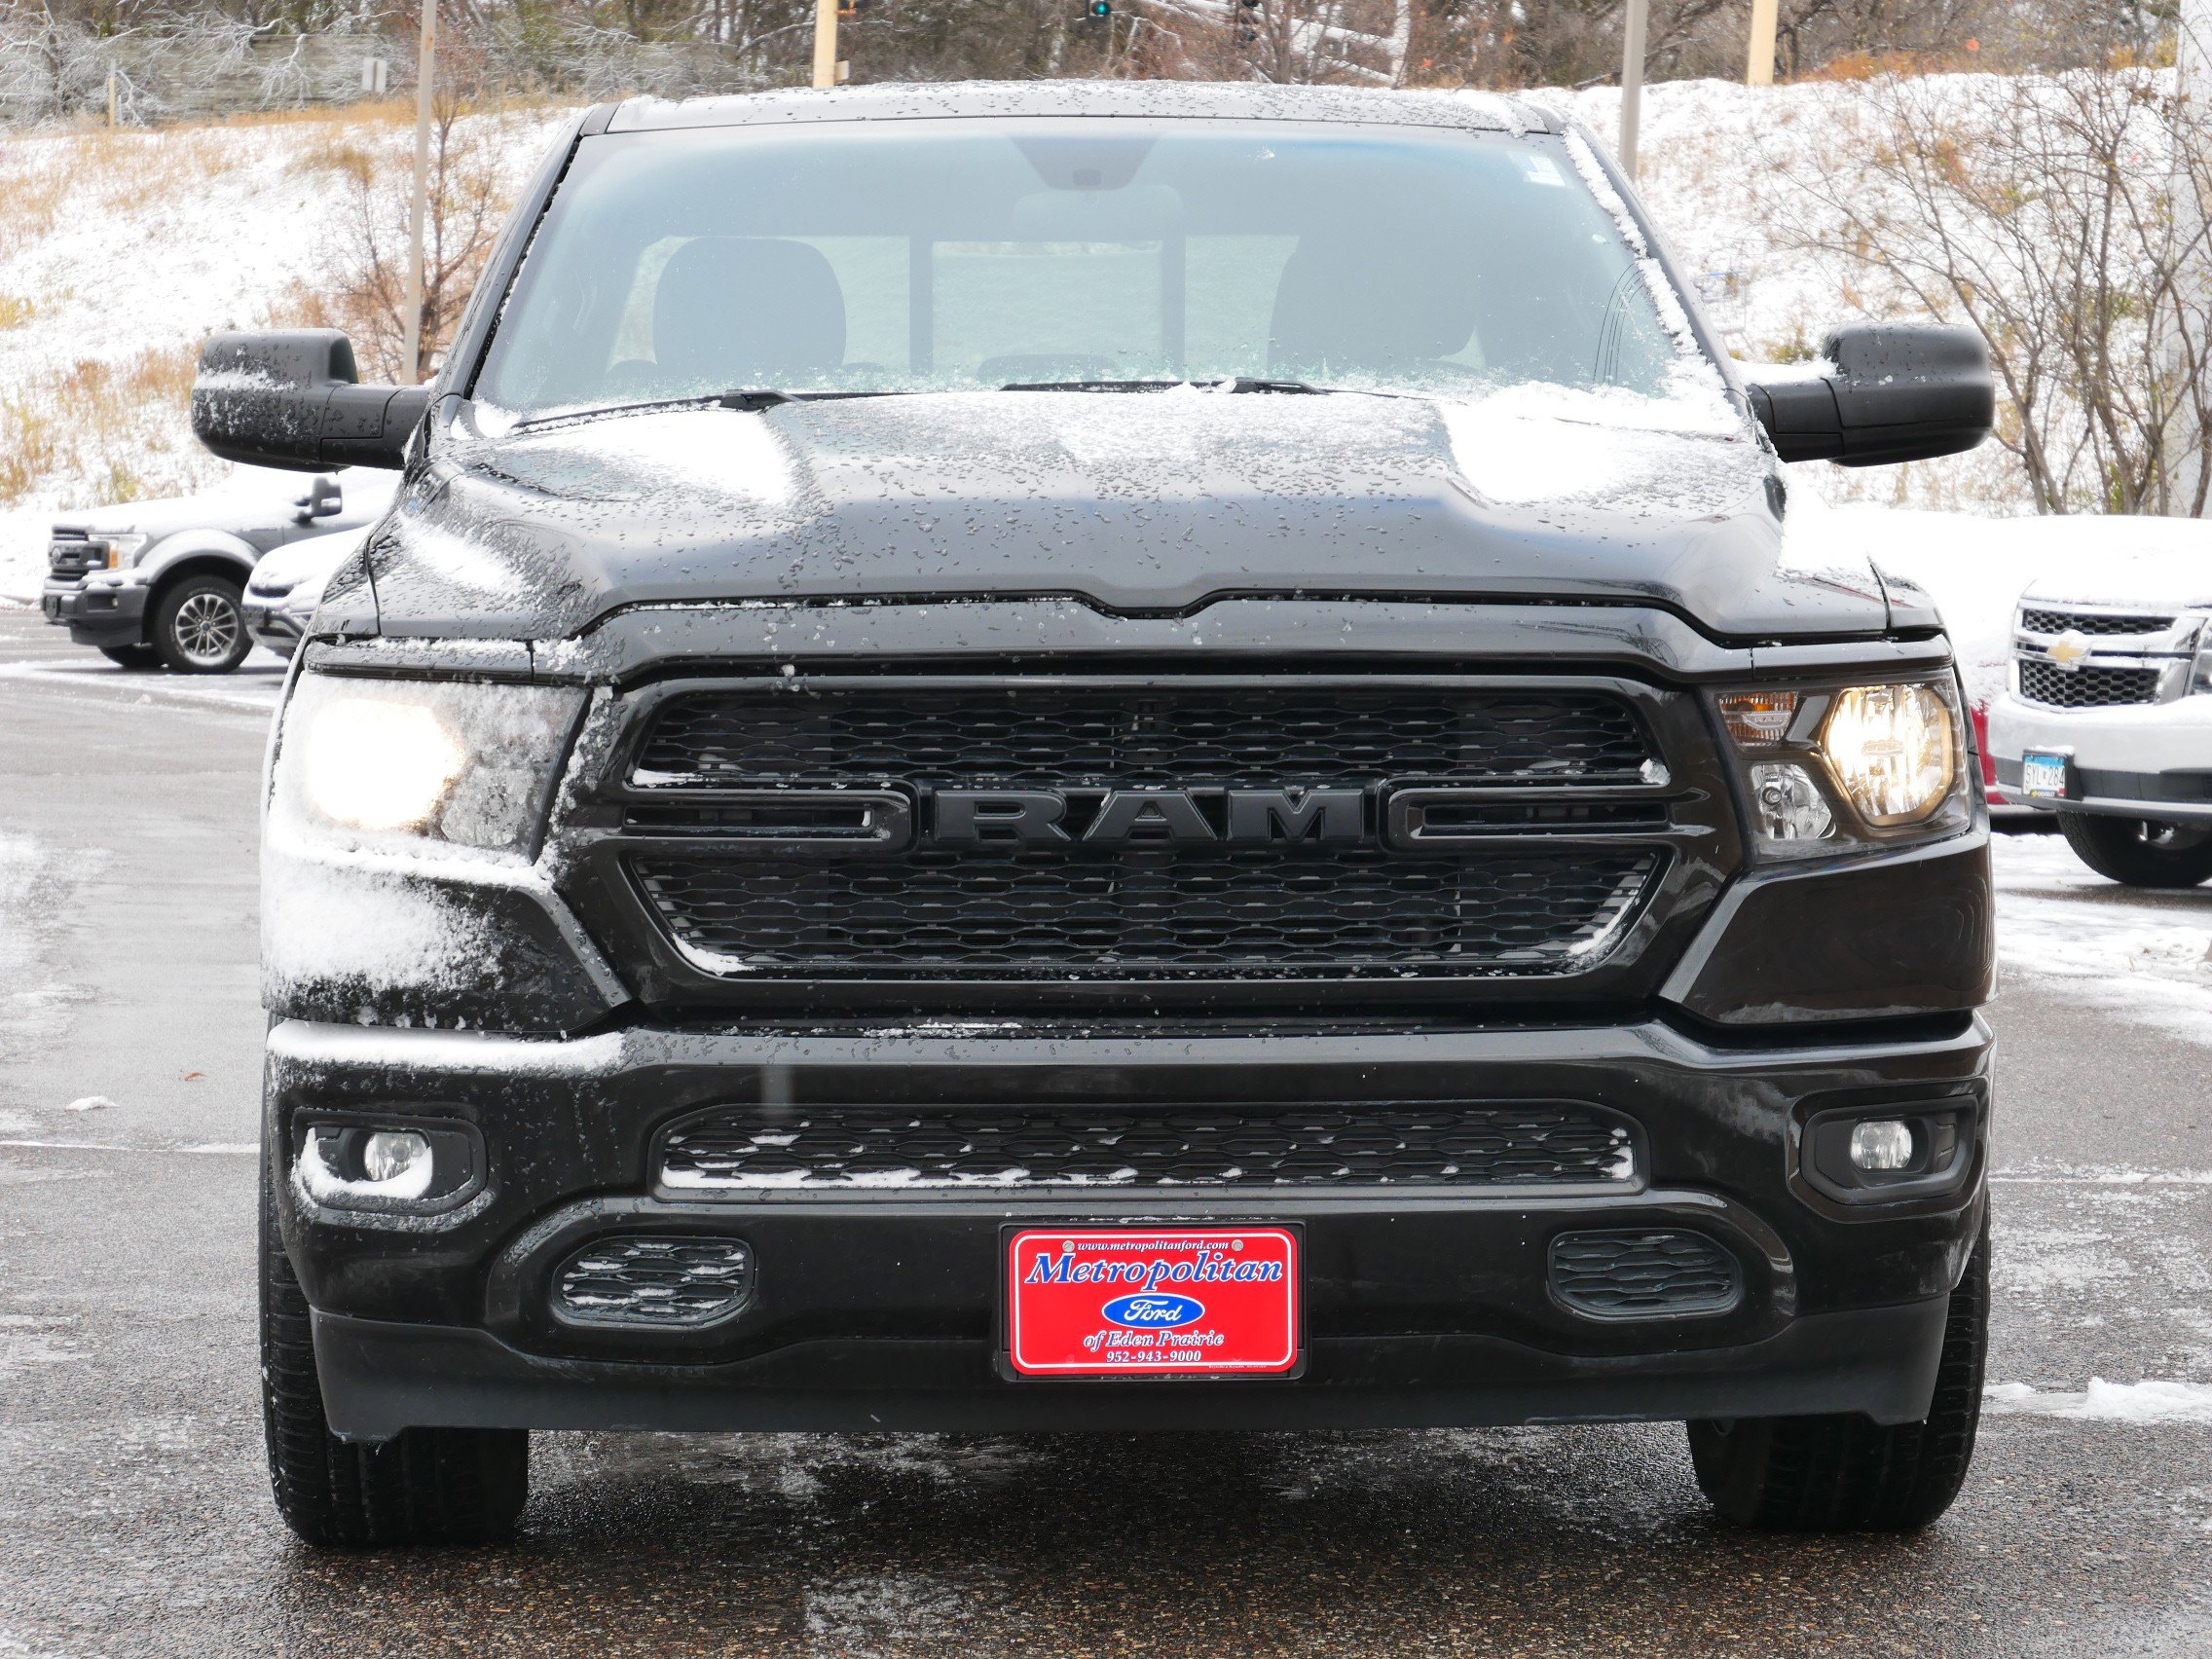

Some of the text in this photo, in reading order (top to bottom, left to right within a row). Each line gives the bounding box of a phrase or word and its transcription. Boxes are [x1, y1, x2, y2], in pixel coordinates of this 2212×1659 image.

[934, 790, 1365, 841] RAM
[1077, 1239, 1229, 1253] www.metropolitanford.com
[1024, 1250, 1283, 1292] Metropolitan
[1124, 1299, 1182, 1321] Ford
[1084, 1329, 1225, 1352] of Eden Prairie
[1106, 1350, 1201, 1363] 952-943-9000
